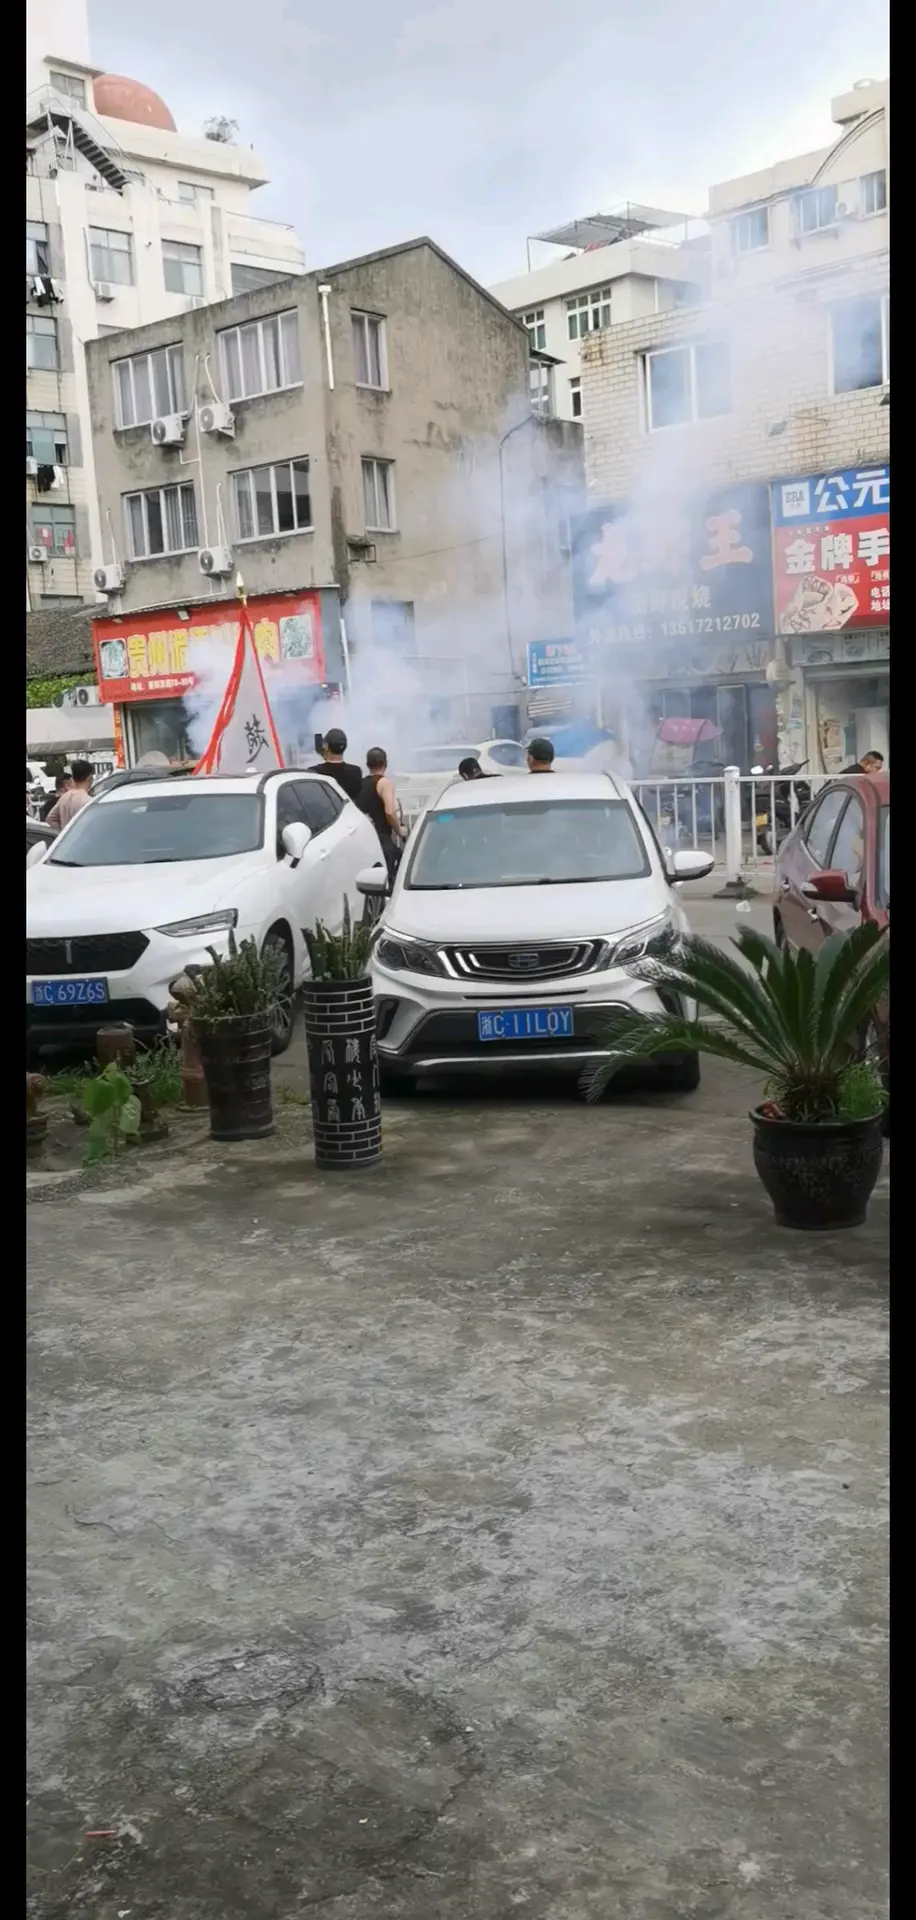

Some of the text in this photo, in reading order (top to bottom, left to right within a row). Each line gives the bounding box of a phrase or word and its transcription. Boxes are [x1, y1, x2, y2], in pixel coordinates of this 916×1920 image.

[814, 470, 890, 513] 公元
[588, 509, 753, 586] 龙王
[784, 528, 890, 575] 金牌手
[660, 613, 761, 636] 13617212702
